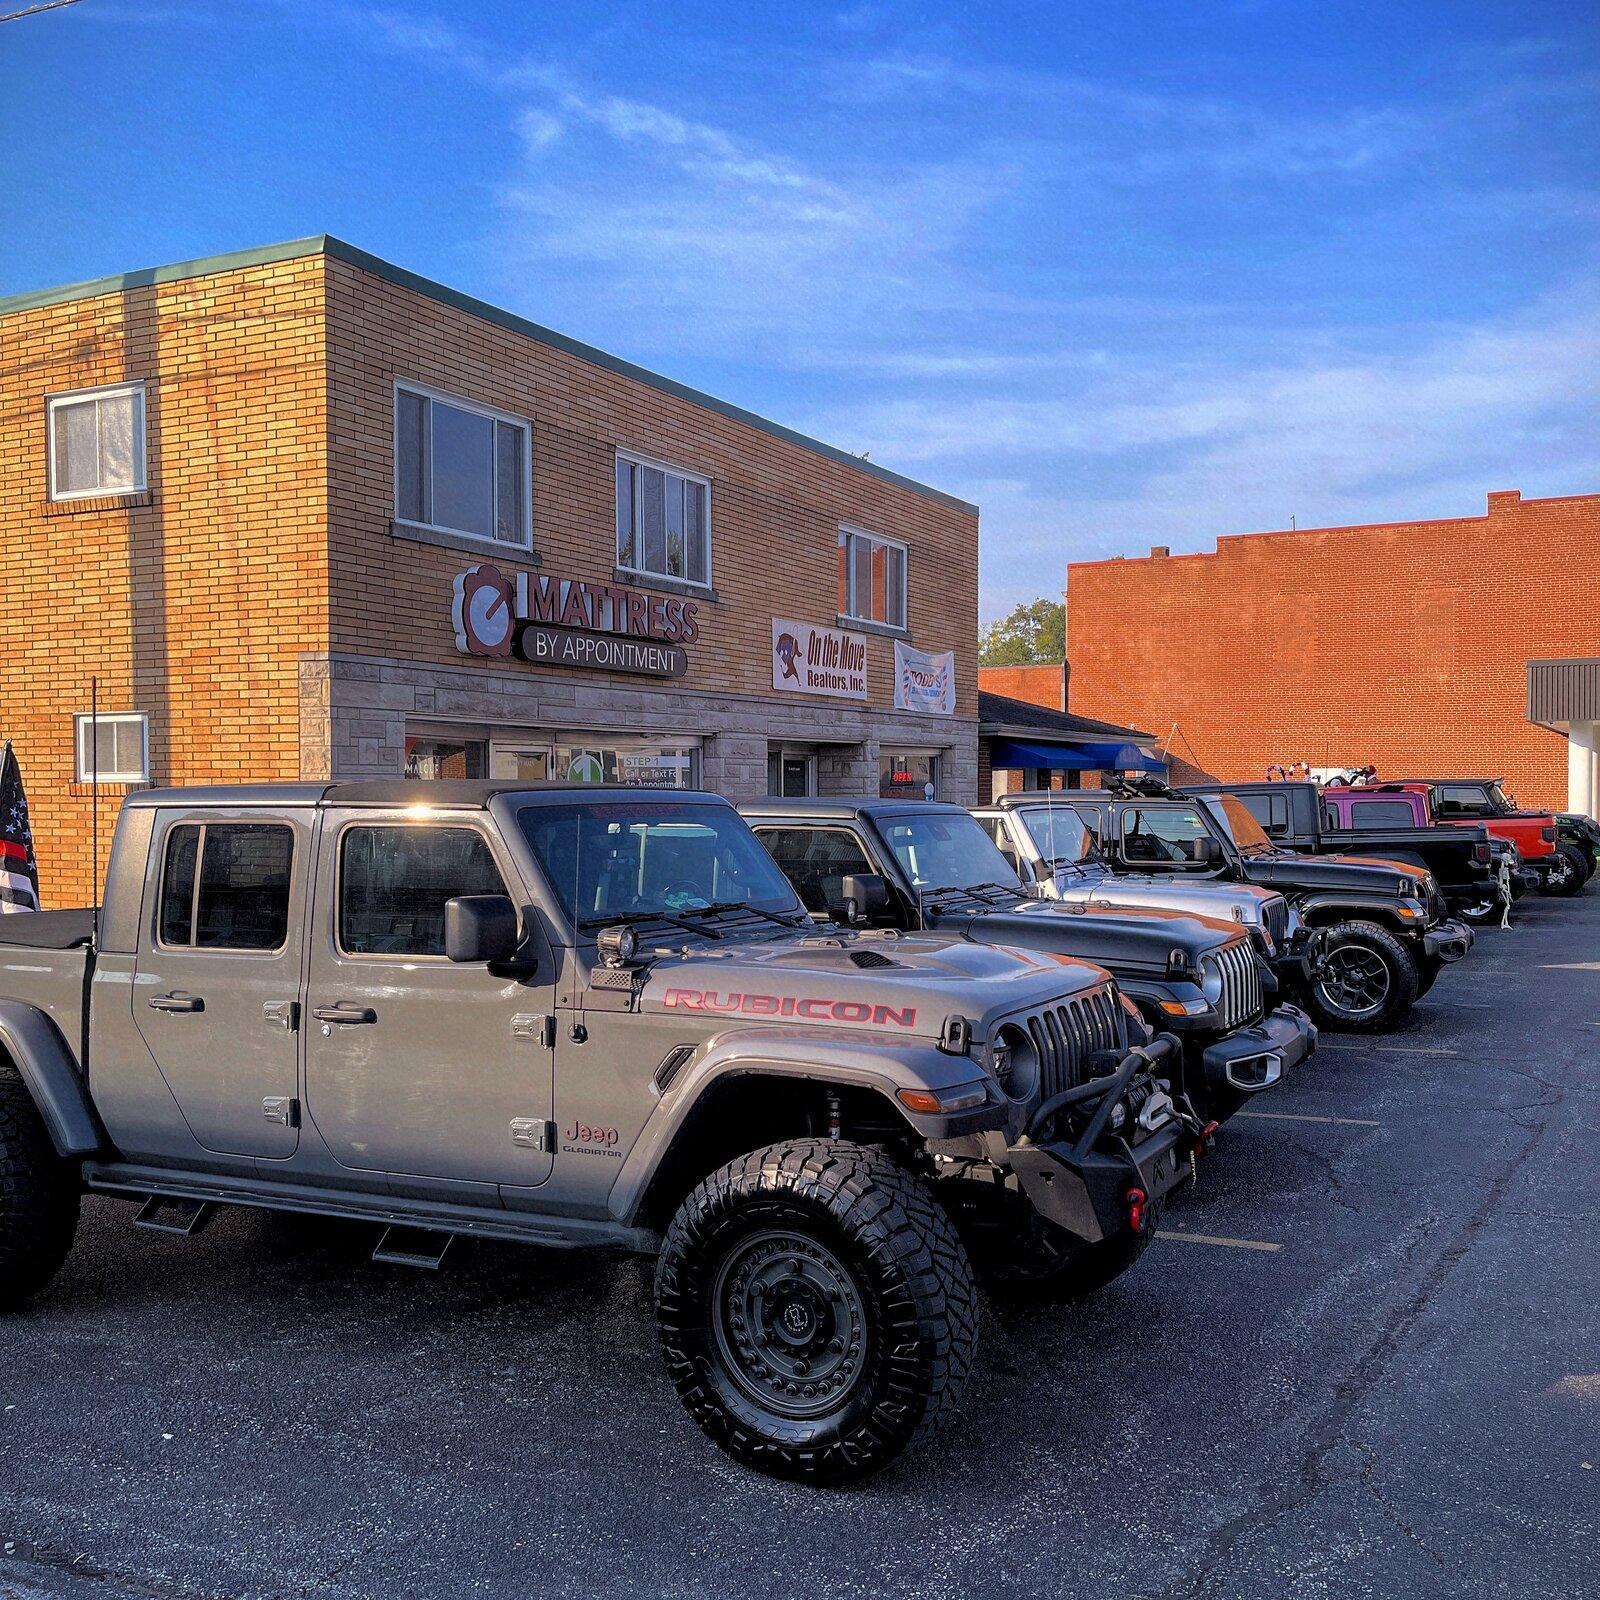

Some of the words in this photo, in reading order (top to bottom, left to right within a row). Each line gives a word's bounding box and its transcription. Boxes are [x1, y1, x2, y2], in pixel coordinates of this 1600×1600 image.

[522, 572, 699, 644] MATTRESS
[536, 632, 559, 656] BY
[562, 636, 677, 671] APPOINTMENT
[807, 629, 821, 666] On
[821, 632, 839, 669] the
[839, 635, 865, 672] Move
[807, 669, 849, 692] Realtors,
[849, 674, 866, 692] Inc.
[624, 769, 640, 778] Call
[651, 769, 667, 778] Text
[626, 757, 651, 766] STEP
[892, 771, 912, 782] OPEN
[664, 988, 917, 1027] RUBICON
[563, 1120, 619, 1147] Jeep
[562, 1145, 622, 1158] GLADIATOR
